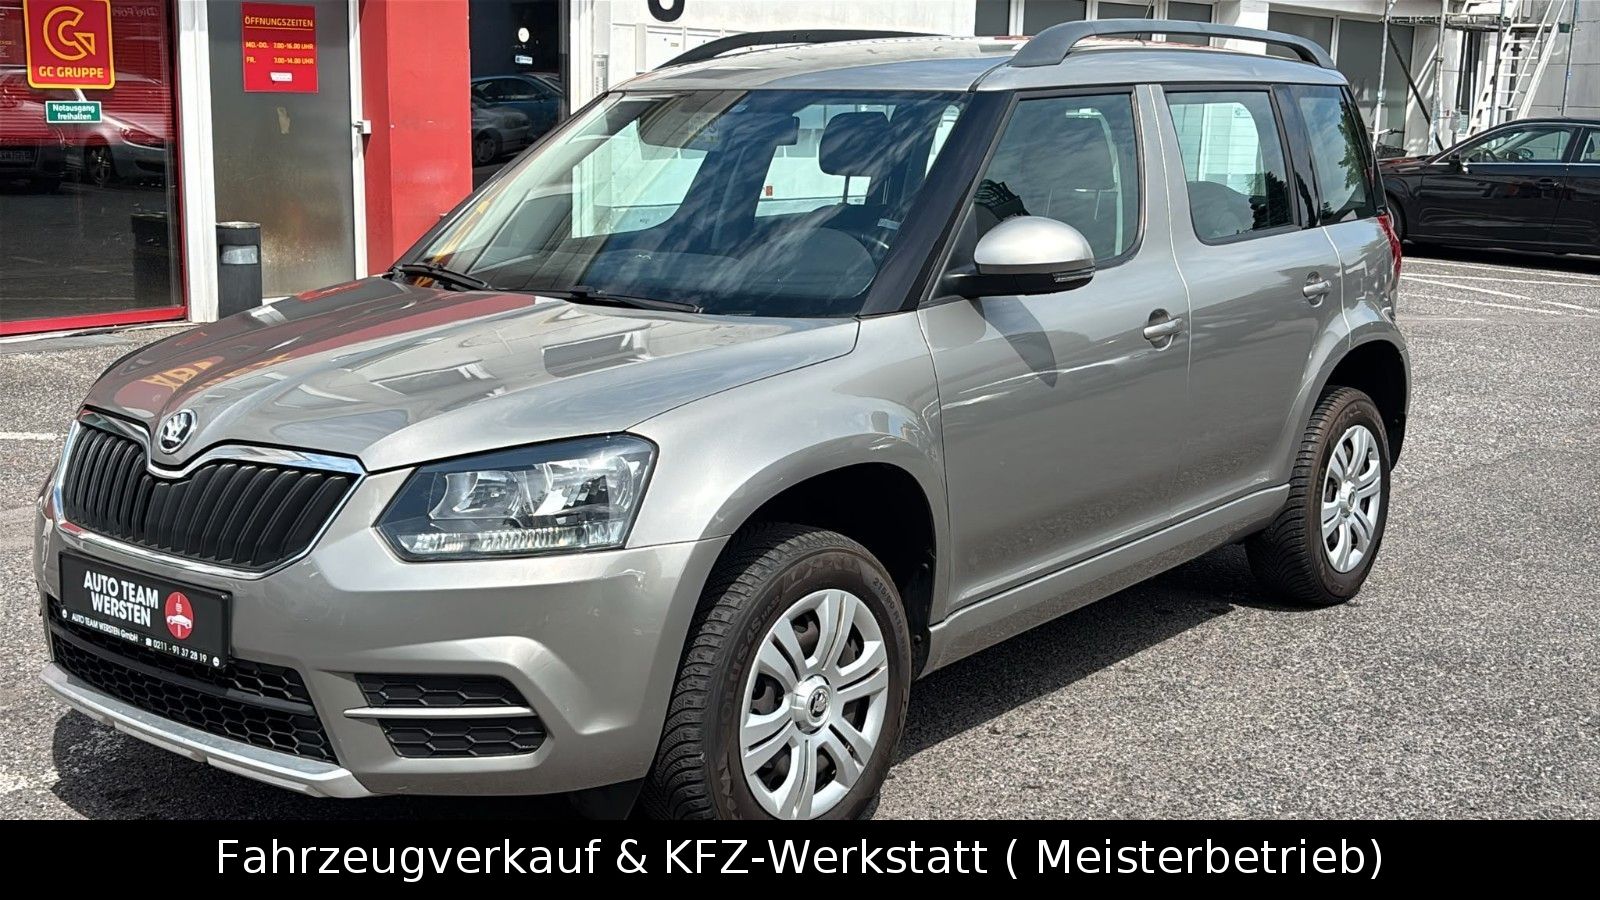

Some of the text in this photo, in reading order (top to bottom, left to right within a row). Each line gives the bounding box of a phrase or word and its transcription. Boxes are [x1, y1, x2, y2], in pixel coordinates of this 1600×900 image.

[244, 15, 314, 28] ÖFFNUNGSZEITEN
[38, 66, 104, 79] GC GRUPPE
[52, 103, 95, 117] Notausgang
[57, 112, 92, 121] freihalten
[83, 570, 159, 610] AUTO TEAM
[90, 591, 151, 628] WERSTEN
[71, 612, 139, 642] AUTO TEAM WERSTEN GmbH
[152, 639, 167, 651] 0211
[172, 645, 180, 655] 91
[181, 647, 189, 657] 37
[190, 650, 198, 661] 28
[199, 652, 208, 663] 19
